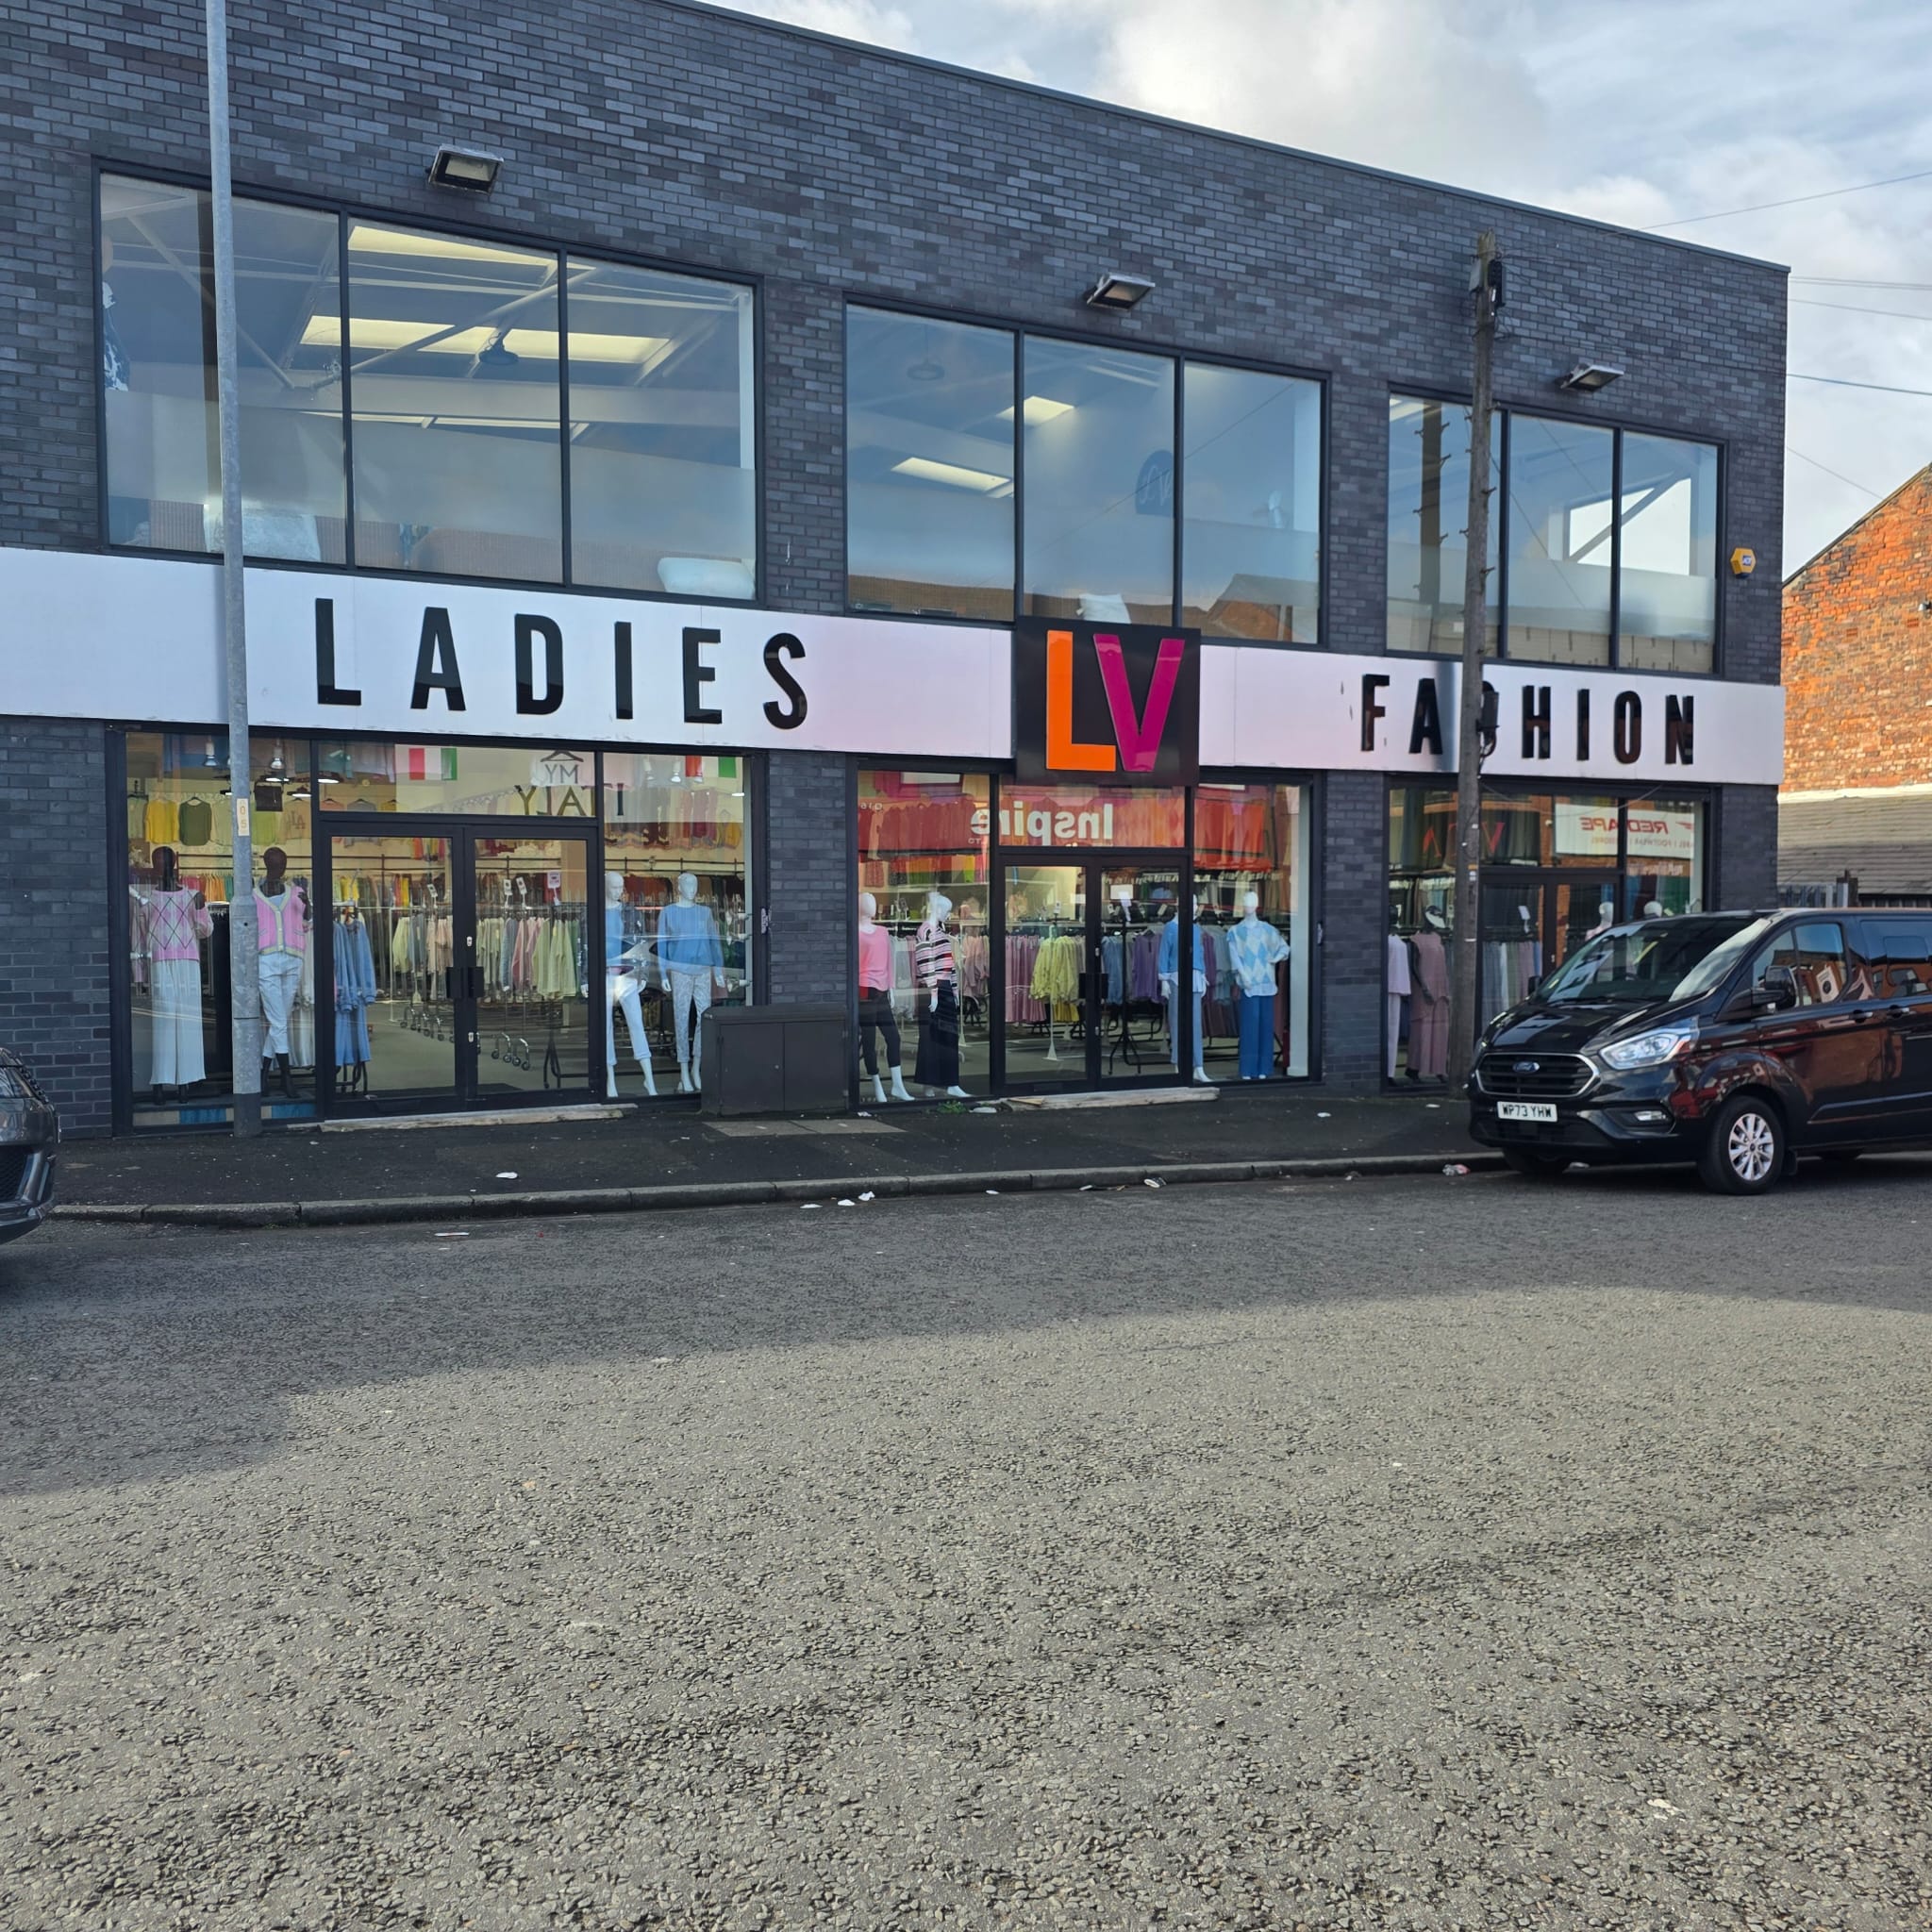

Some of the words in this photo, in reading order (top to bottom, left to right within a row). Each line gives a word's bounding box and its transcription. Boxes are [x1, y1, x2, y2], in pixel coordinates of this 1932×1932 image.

[314, 597, 808, 730] LADIES
[1045, 629, 1186, 773] LV
[1360, 674, 1694, 765] FAHION
[1502, 1104, 1528, 1117] WP73
[1530, 1106, 1552, 1118] YHW
